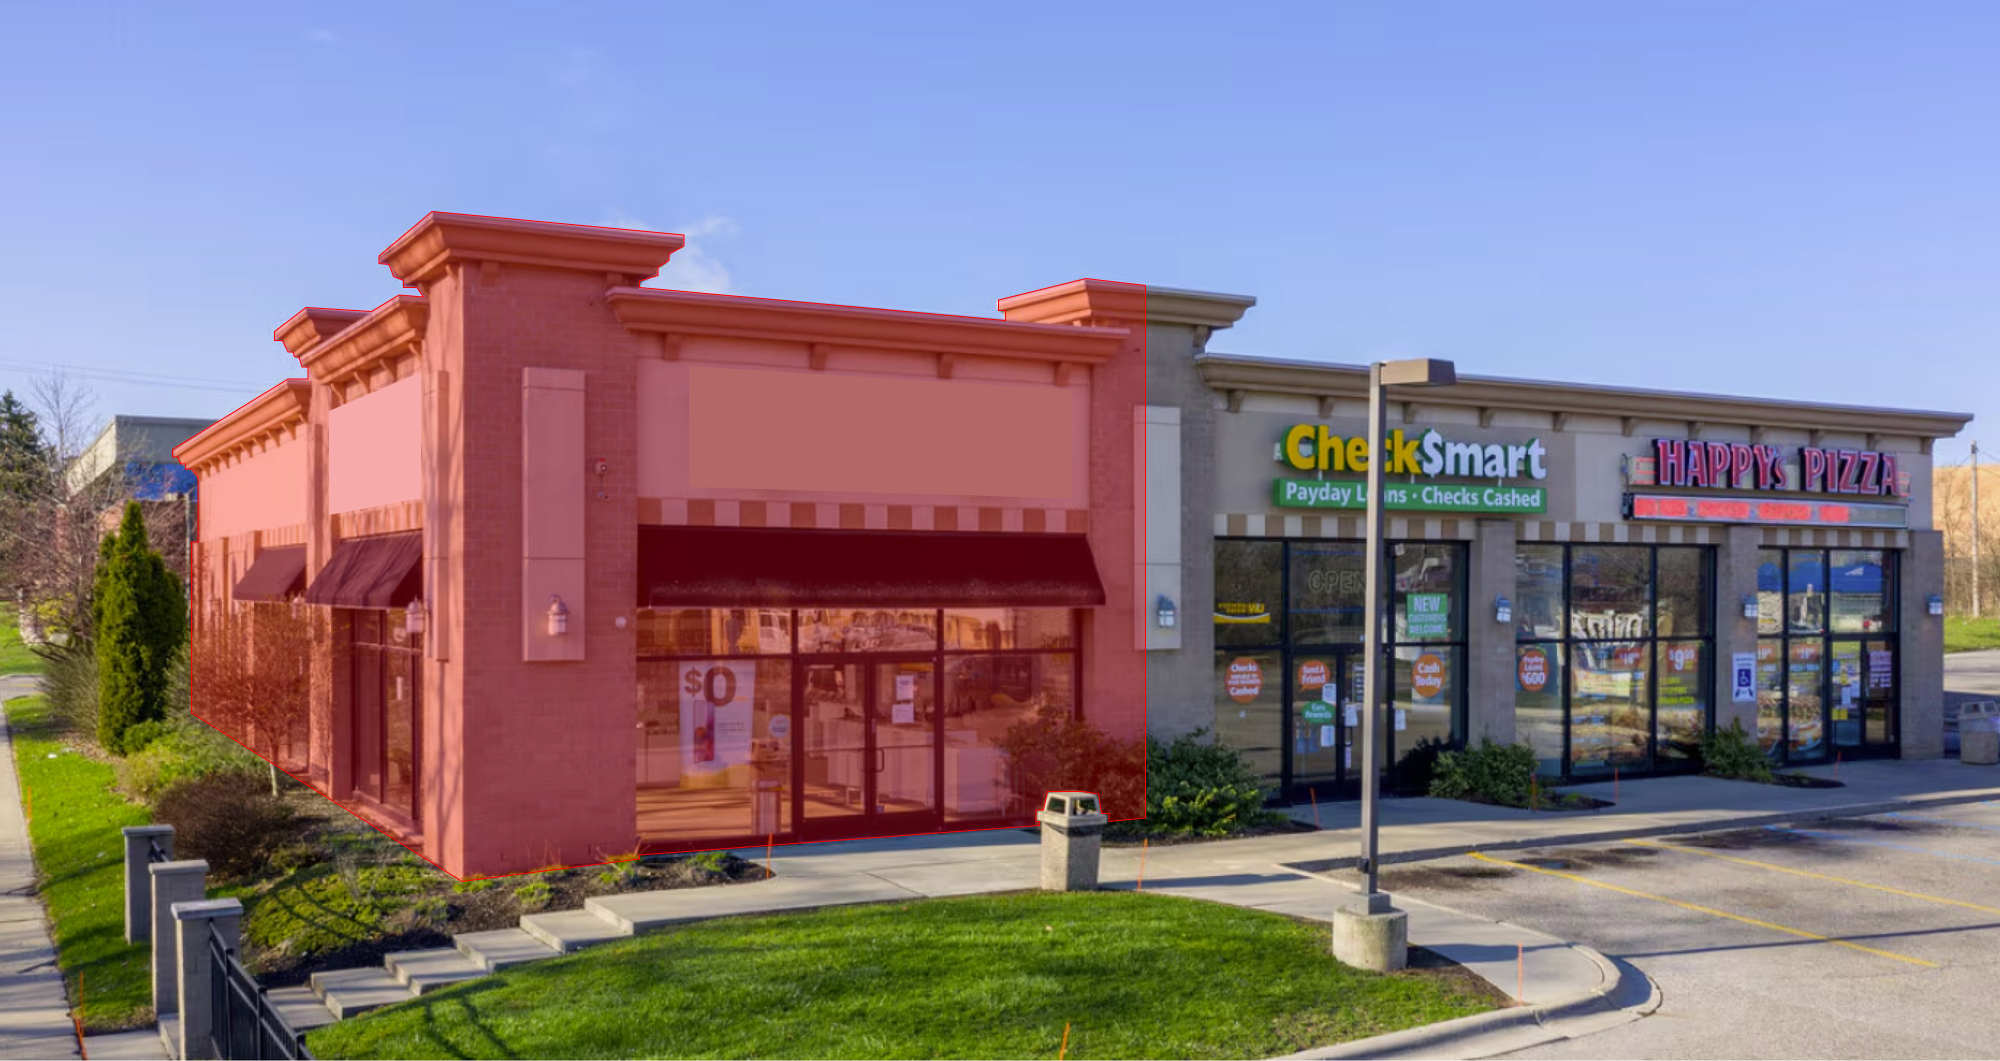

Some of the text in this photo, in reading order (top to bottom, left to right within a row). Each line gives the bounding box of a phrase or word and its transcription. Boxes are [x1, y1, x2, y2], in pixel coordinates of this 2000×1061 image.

[1803, 447, 1898, 496] PIZZA
[1285, 482, 1541, 507] Payday Lns Checks Cashed
[1413, 596, 1441, 612] NEW
[1417, 662, 1440, 673] Cash
[684, 666, 737, 708] $0
[1414, 674, 1442, 687] Today
